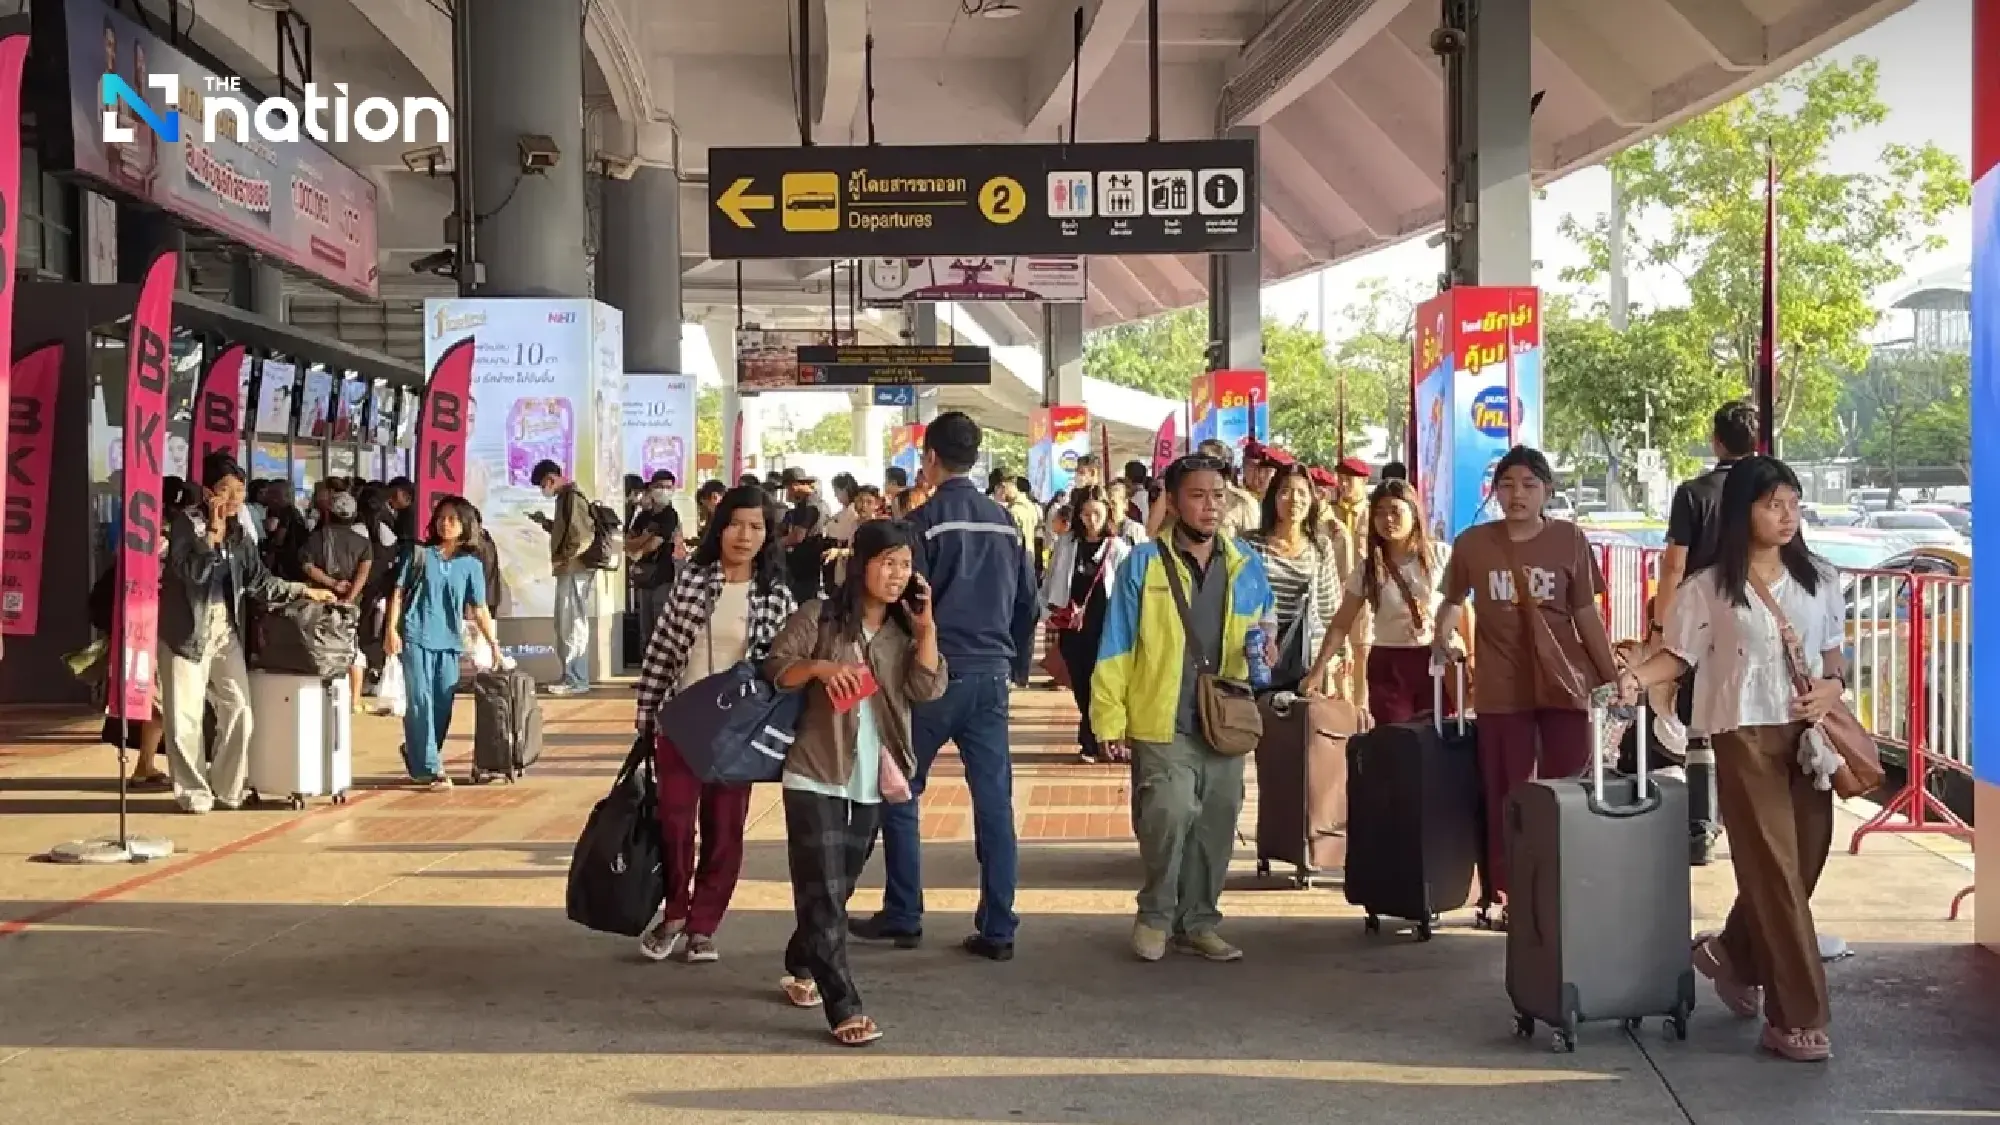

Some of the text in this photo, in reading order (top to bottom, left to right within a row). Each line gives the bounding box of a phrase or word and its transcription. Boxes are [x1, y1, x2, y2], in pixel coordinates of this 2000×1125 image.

[848, 168, 967, 200] ผู้โดยสารขาออก
[992, 184, 1011, 215] 2
[848, 211, 934, 232] Departures
[515, 342, 544, 366] 10
[126, 325, 165, 557] BKS
